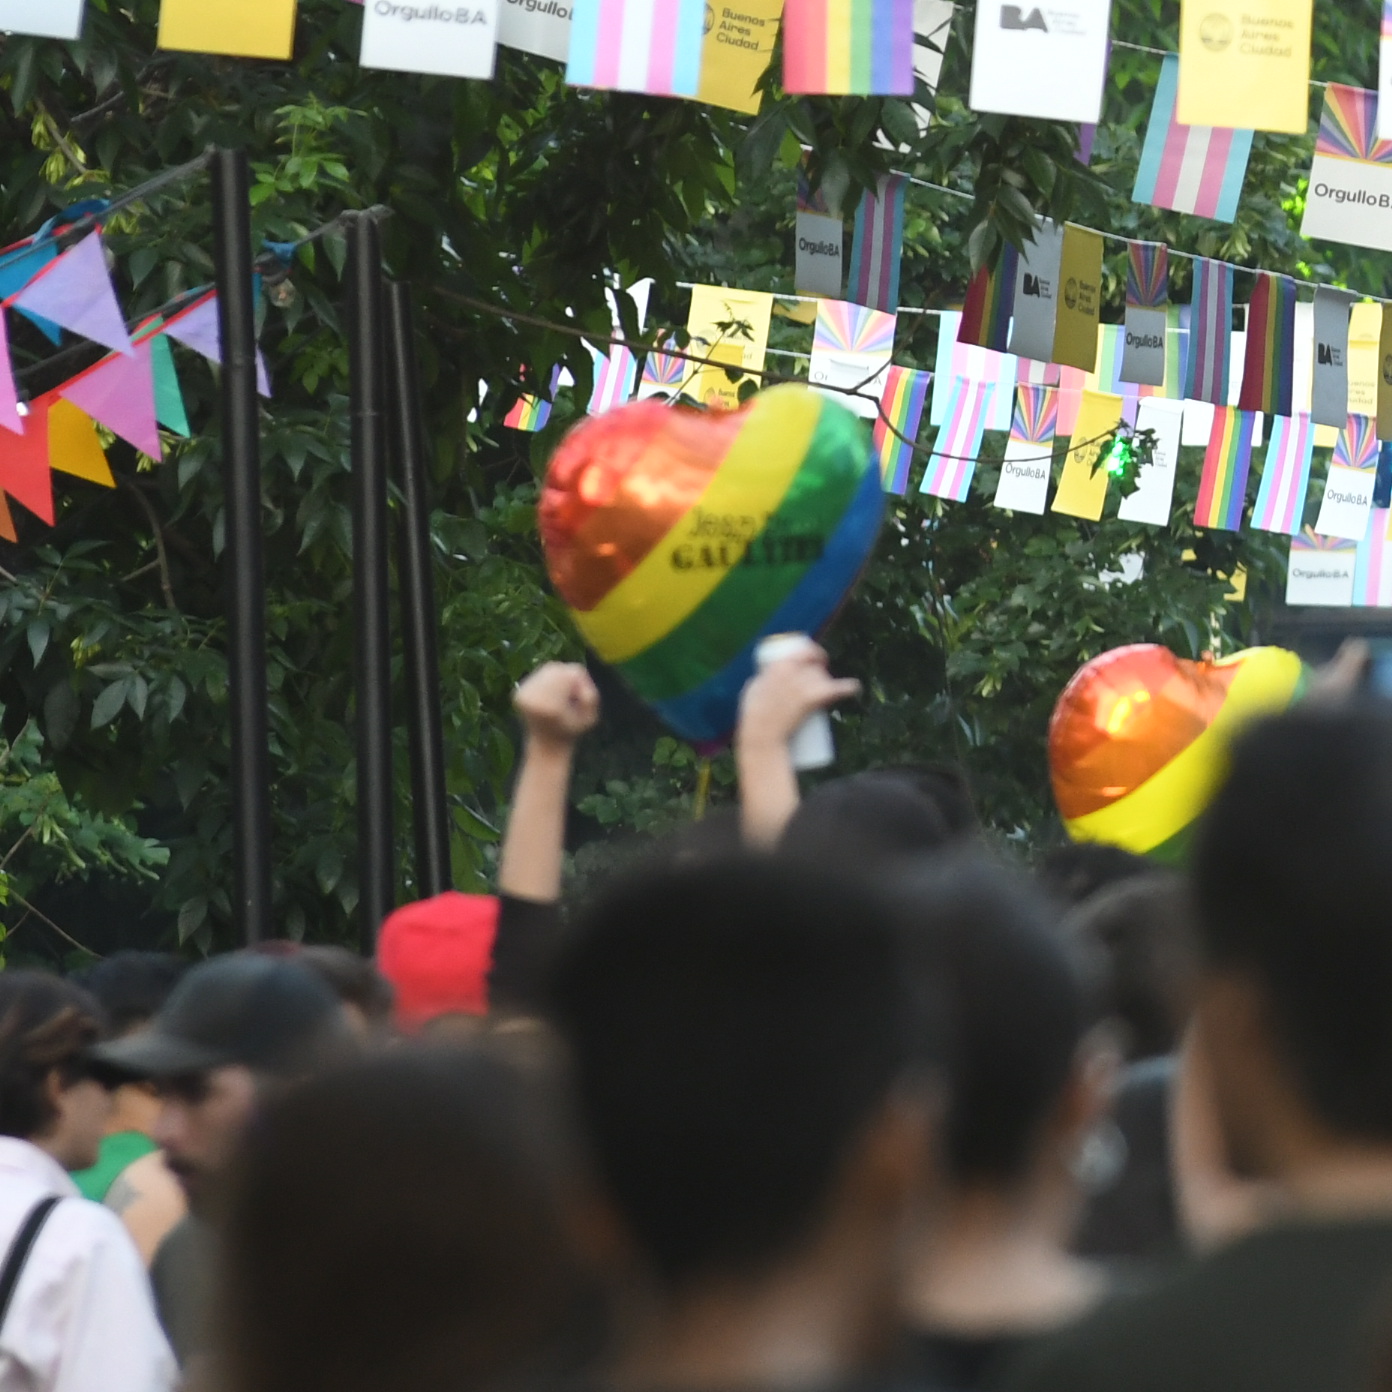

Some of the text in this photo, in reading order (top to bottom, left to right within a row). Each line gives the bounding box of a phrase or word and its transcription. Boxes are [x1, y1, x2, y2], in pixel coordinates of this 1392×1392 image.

[721, 8, 766, 27] Buenos
[1000, 4, 1049, 34] BA
[1241, 14, 1295, 30] Buenos
[719, 20, 752, 37] Aires
[1241, 29, 1280, 43] Aires
[715, 32, 759, 52] Ciudad
[1240, 42, 1292, 58] Ciudad
[799, 236, 841, 257] OrgulloBA
[1023, 273, 1041, 298] BA
[1126, 331, 1164, 349] OrgulloBA
[1317, 343, 1333, 366] BA
[1005, 463, 1046, 480] OrgulloBA
[1327, 488, 1368, 506] OrgulloBA
